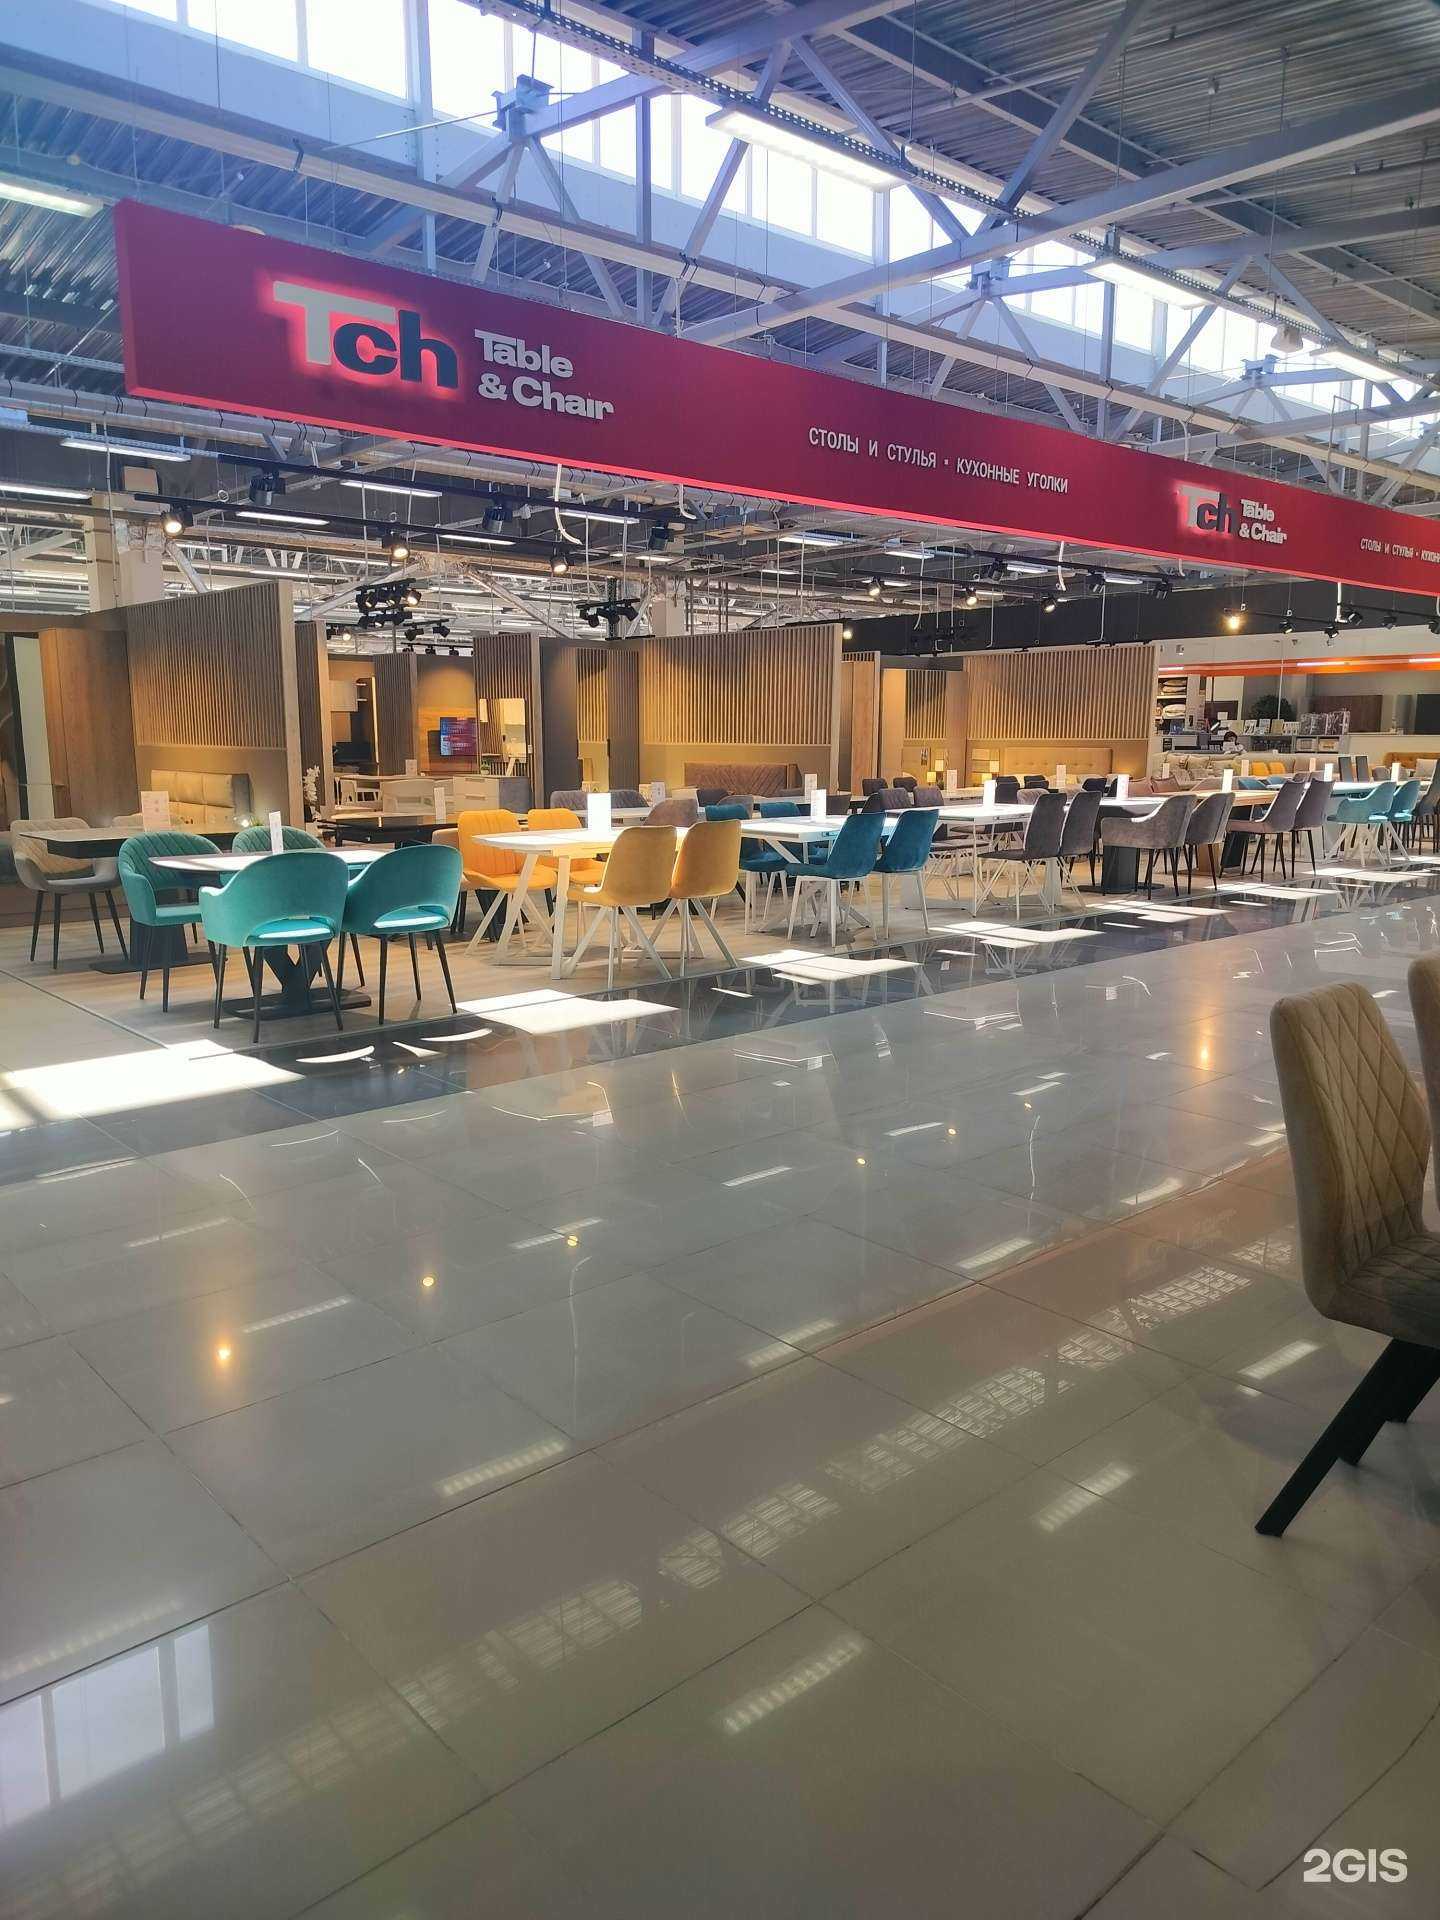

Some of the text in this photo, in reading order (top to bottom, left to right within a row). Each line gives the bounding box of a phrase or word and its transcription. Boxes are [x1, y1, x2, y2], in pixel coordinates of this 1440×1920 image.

[273, 280, 459, 389] Tch
[475, 329, 573, 378] Table
[478, 372, 615, 420] & Chair
[809, 427, 1068, 494] СТОЛЫ И СТУЛЬЯ КУХОННЫЕ УГОЛКИ
[1180, 485, 1239, 534] Tch
[1239, 522, 1287, 544] & Chair
[1241, 499, 1275, 522] Table
[1360, 538, 1381, 552] СТОЛЫ
